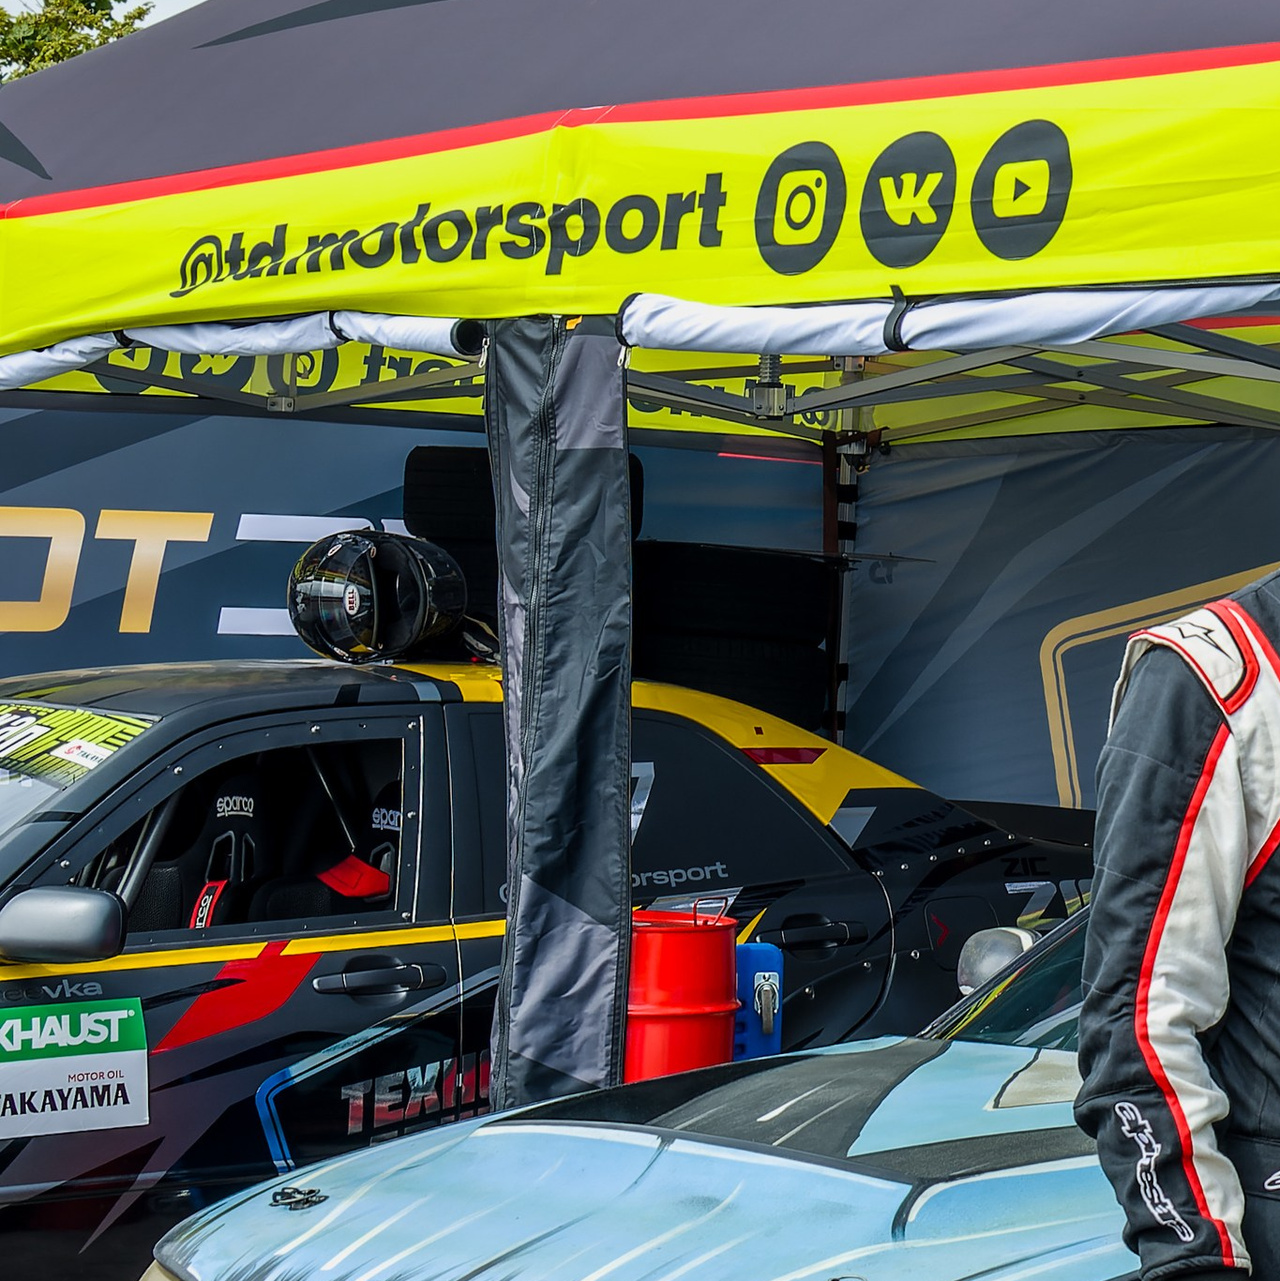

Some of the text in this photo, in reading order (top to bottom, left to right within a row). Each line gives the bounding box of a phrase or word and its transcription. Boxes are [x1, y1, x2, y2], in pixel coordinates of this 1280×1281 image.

[170, 172, 728, 298] @td.motorsport
[347, 588, 356, 611] BELL
[216, 795, 254, 817] sparco
[1001, 857, 1050, 876] ZIC
[67, 1070, 124, 1083] MOTOR OIL
[0, 1083, 130, 1116] AKAYAMA
